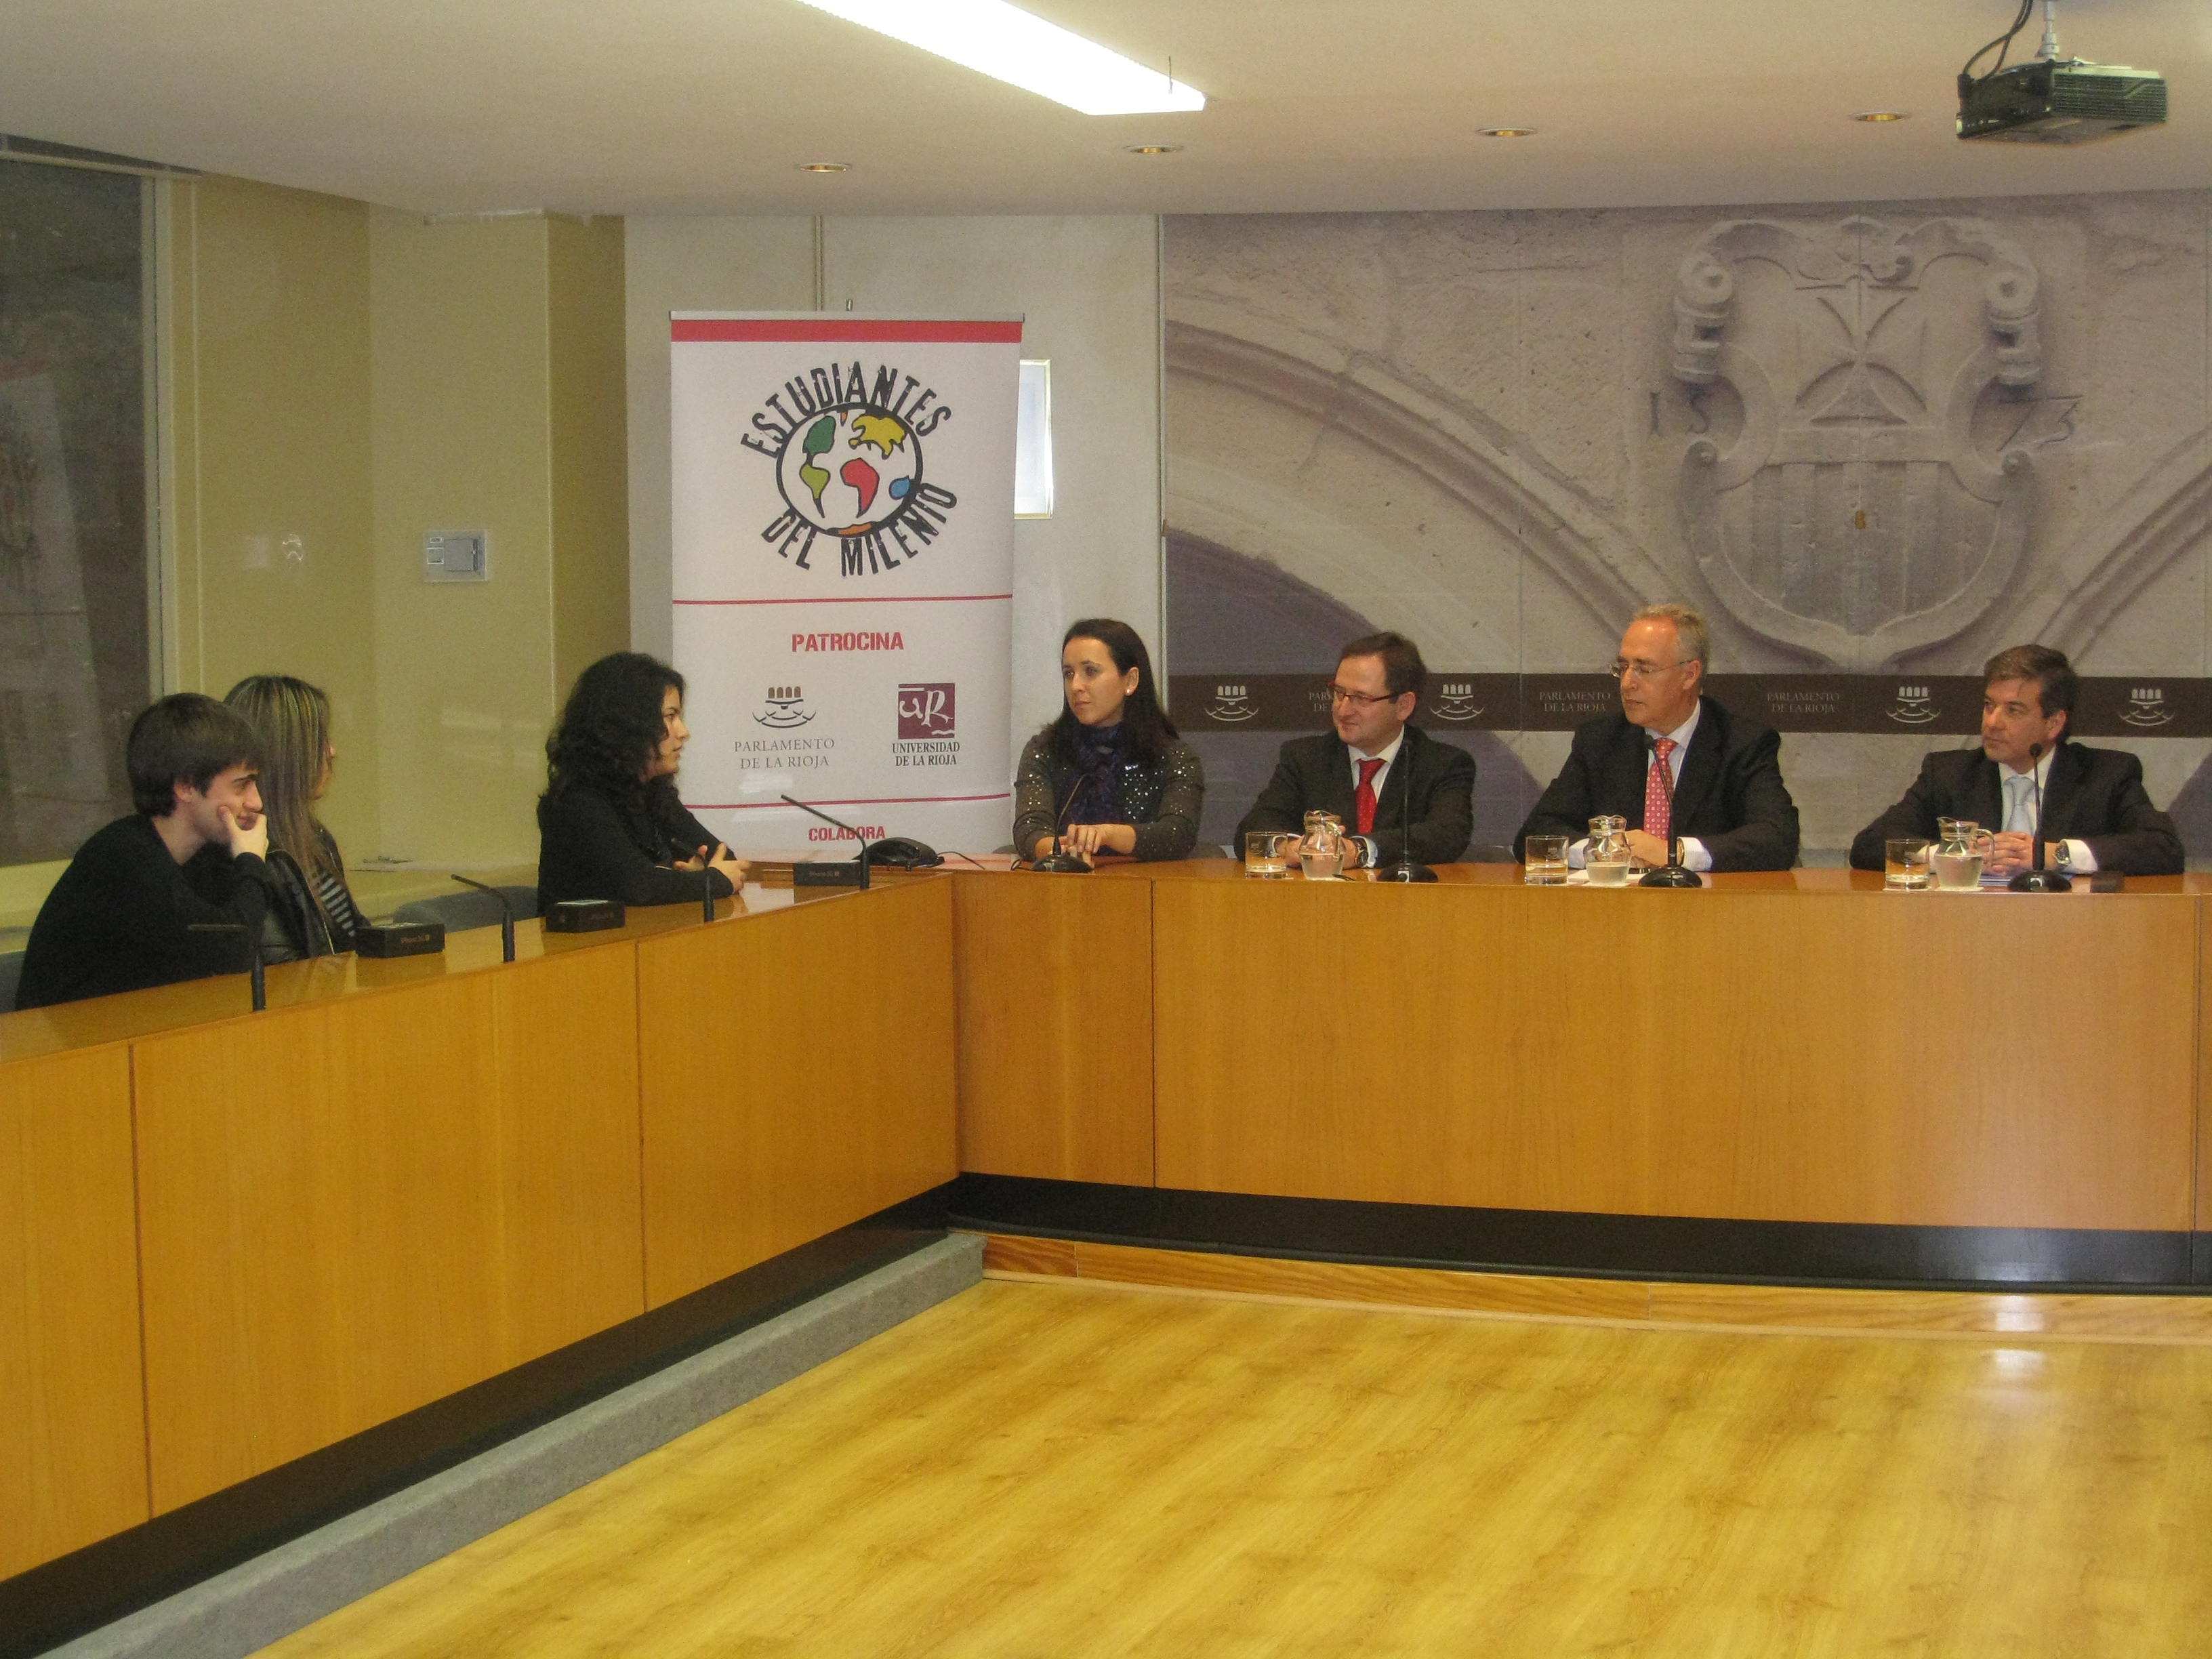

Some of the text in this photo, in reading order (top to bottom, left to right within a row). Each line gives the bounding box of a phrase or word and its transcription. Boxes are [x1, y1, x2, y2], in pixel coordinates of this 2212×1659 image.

[741, 361, 951, 459] ESTUDIANTES
[761, 483, 958, 577] DEL MILENIO
[792, 632, 904, 652] PATROCINA
[1539, 691, 1611, 701] PARLAMENTO
[1767, 692, 1840, 701] PARLAMENTO
[734, 738, 835, 752] PARLAMENTO
[892, 741, 960, 754] UNIVERSIDAD
[740, 756, 829, 769] DE LA RIOJA
[895, 754, 957, 766] DE LA RIOJA
[808, 825, 886, 842] COLABORA
